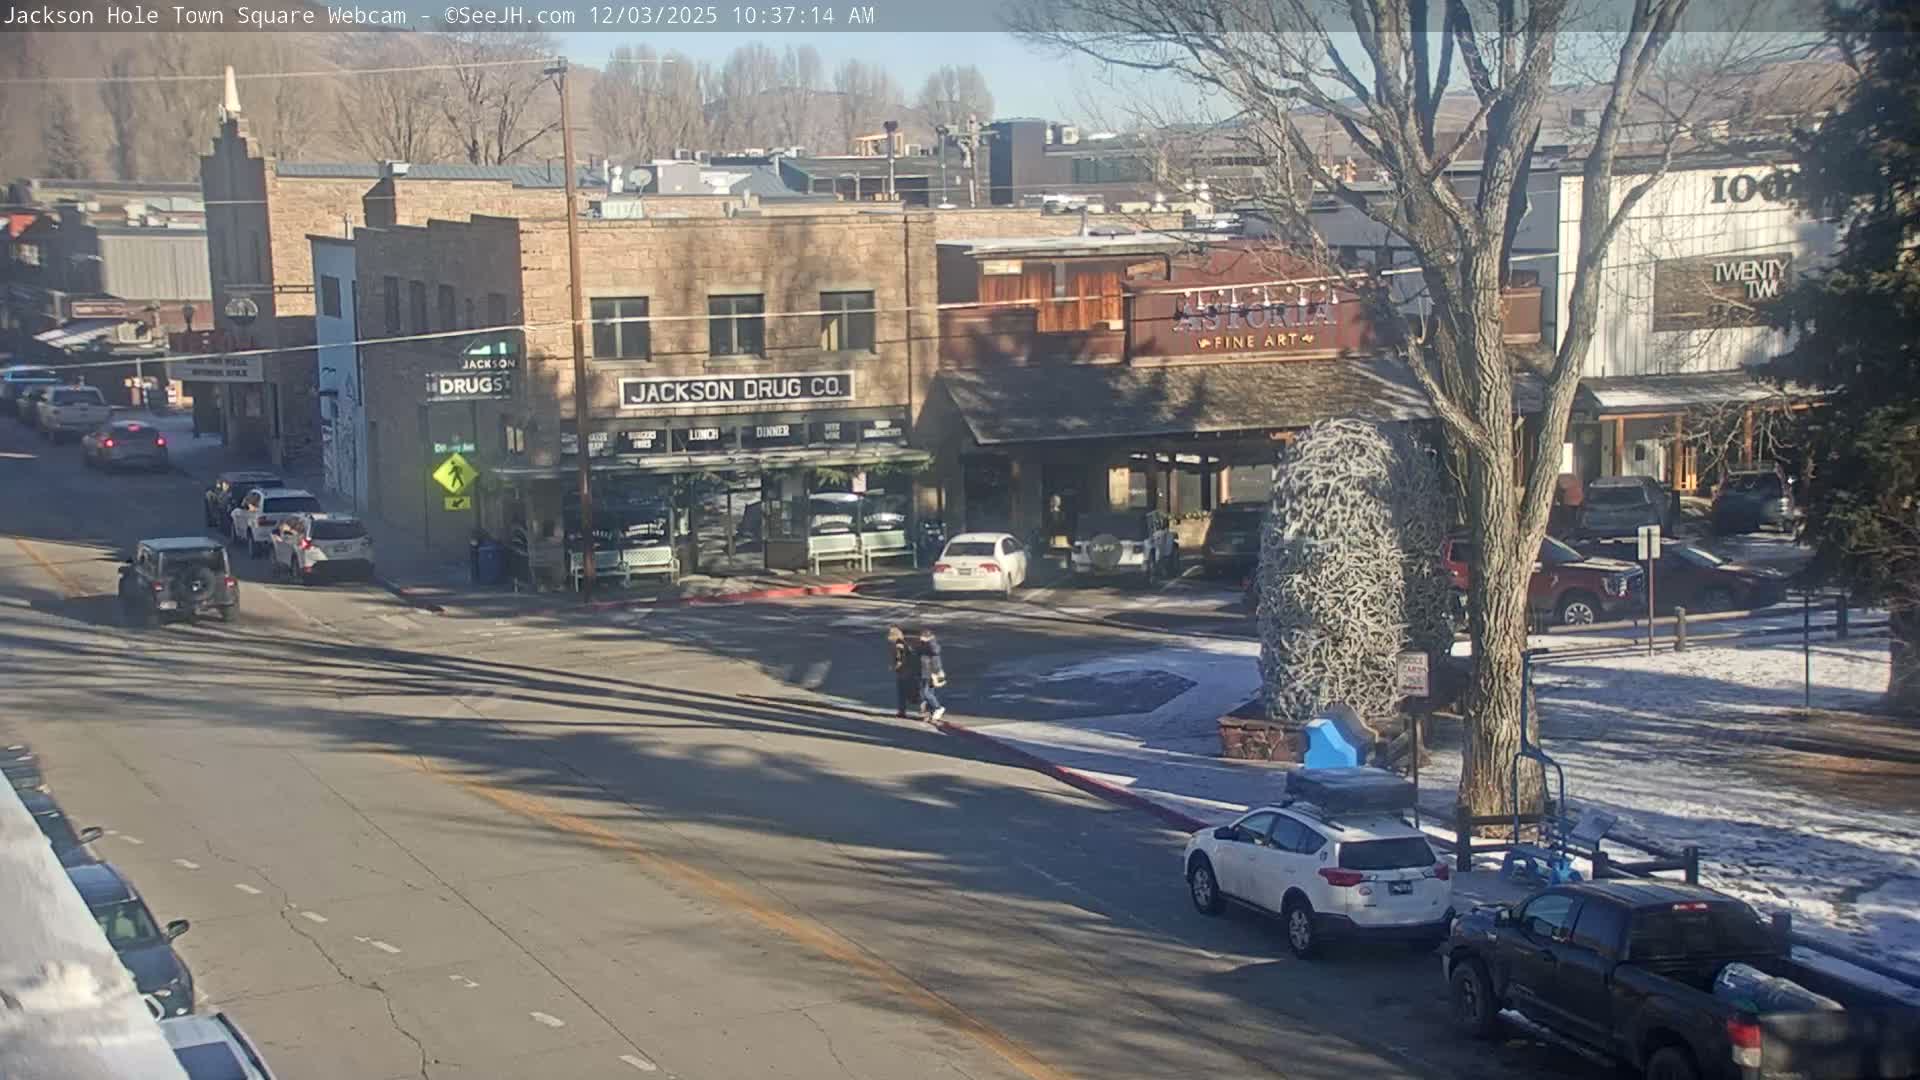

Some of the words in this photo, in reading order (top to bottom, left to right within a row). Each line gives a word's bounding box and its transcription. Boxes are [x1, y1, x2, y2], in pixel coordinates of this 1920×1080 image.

[1714, 259, 1788, 281] TWENTY
[1745, 280, 1779, 299] TW
[1214, 335, 1255, 349] FINE
[1264, 333, 1298, 347] ART
[462, 359, 517, 369] JACKSON
[439, 377, 504, 395] DRUGS
[631, 381, 735, 403] JACKSON
[744, 378, 802, 400] DRUG
[811, 377, 843, 396] CO.
[688, 428, 720, 441] LUNCH
[756, 424, 791, 438] DINNER
